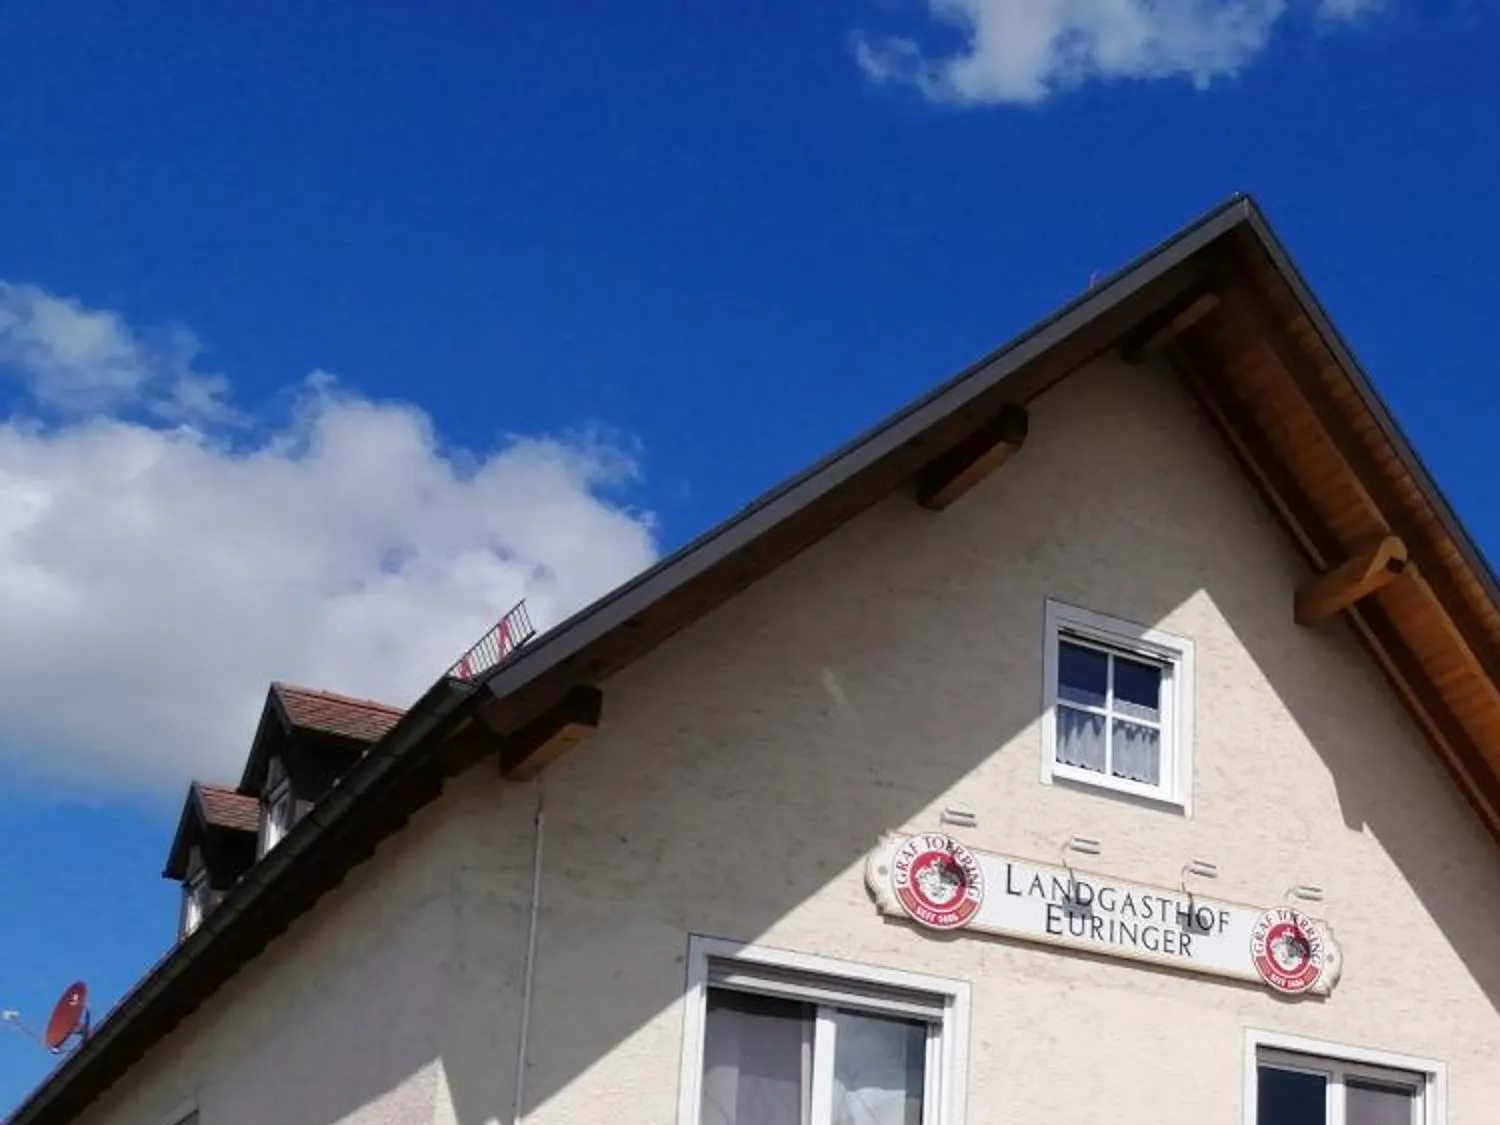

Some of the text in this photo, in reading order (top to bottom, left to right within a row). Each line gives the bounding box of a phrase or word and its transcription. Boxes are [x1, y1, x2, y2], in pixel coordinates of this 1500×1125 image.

[896, 842, 918, 885] GRAF
[1006, 863, 1230, 933] LANDGASTHOF
[1046, 903, 1193, 957] EURINGER
[1254, 914, 1273, 953] GRAF
